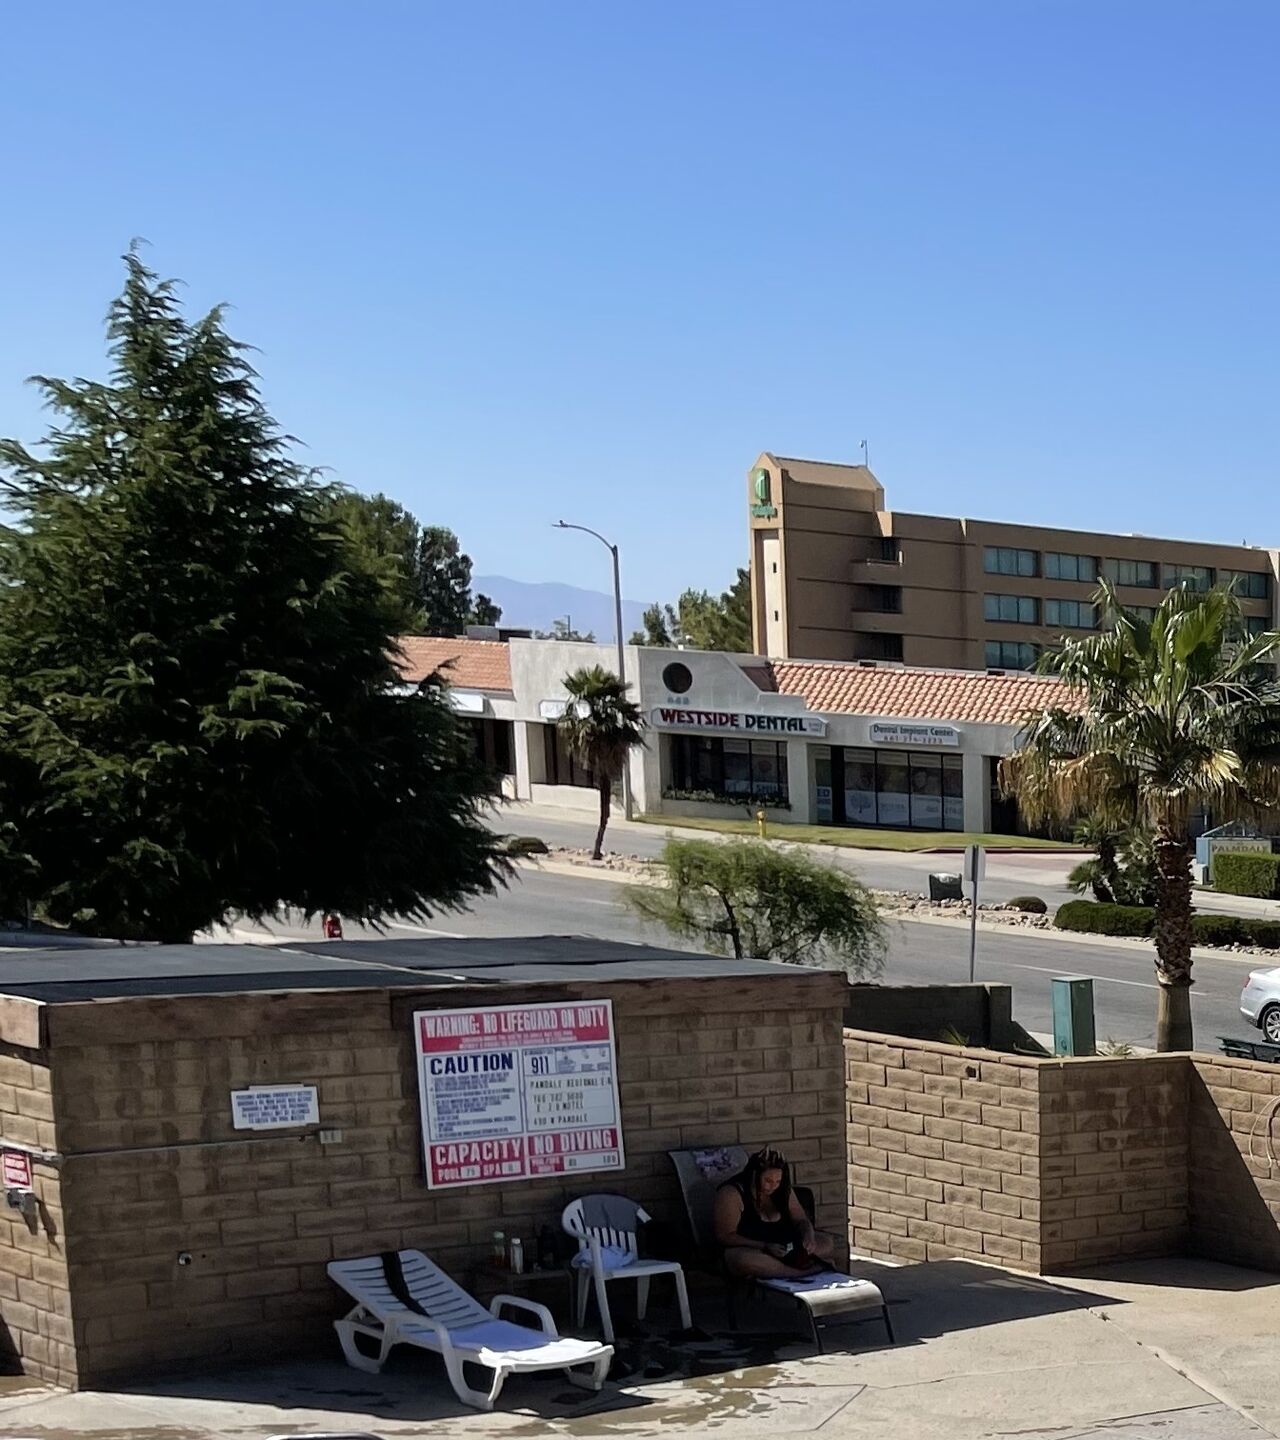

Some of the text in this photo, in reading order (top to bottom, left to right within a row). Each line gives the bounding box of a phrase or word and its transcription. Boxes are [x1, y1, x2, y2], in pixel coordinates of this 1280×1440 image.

[660, 708, 739, 727] WESTSIDE
[745, 714, 807, 732] DENTAL
[873, 724, 898, 734] Dental
[425, 1007, 604, 1038] WARNING: NO LIFEGUARD ON DUTY
[430, 1052, 514, 1075] CAUTION
[531, 1056, 549, 1074] 911
[435, 1138, 521, 1165] CAPACITY
[534, 1129, 613, 1155] NO DIVING
[438, 1166, 460, 1182] POOL
[483, 1161, 501, 1176] SPA
